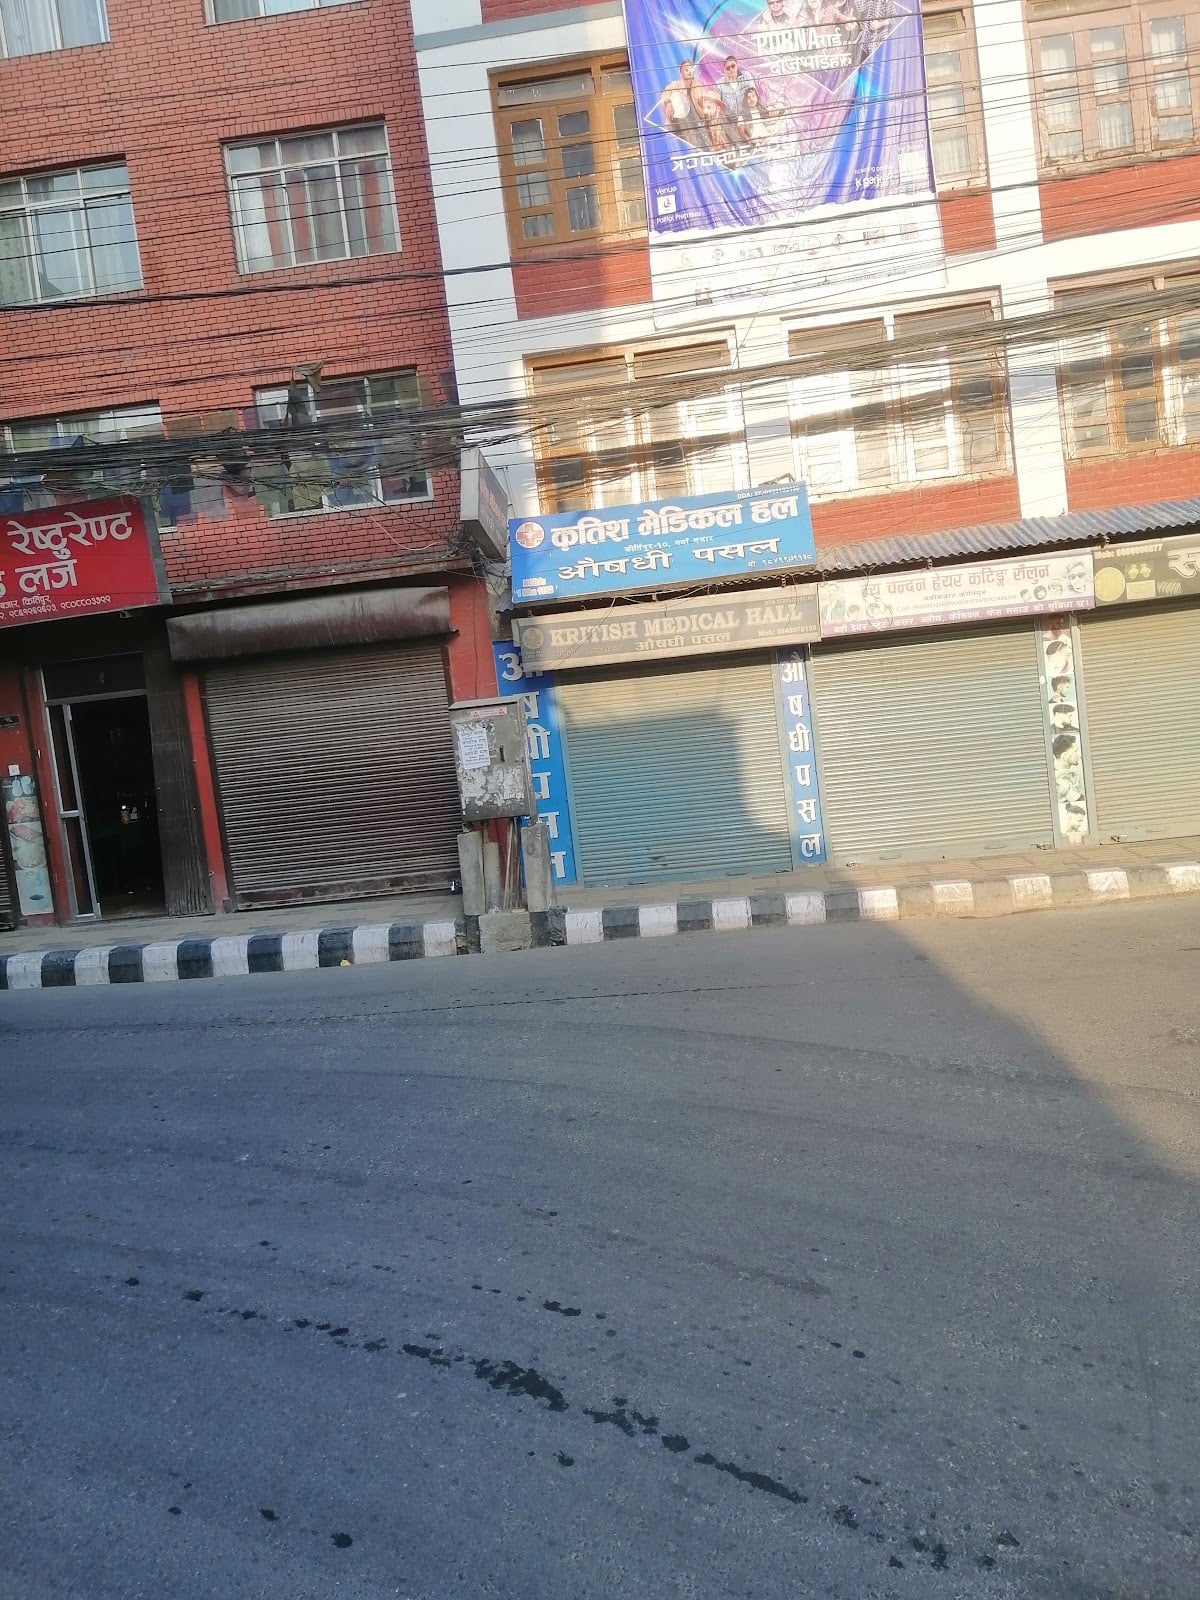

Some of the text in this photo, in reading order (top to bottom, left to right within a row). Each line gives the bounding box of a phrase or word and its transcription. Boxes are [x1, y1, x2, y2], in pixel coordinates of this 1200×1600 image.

[656, 186, 677, 195] Venue
[551, 496, 799, 552] कृतिश मेडिकल हल
[692, 537, 781, 562] पसल
[15, 559, 78, 594] लज
[550, 603, 803, 648] KRITISH MEDICAL HALL
